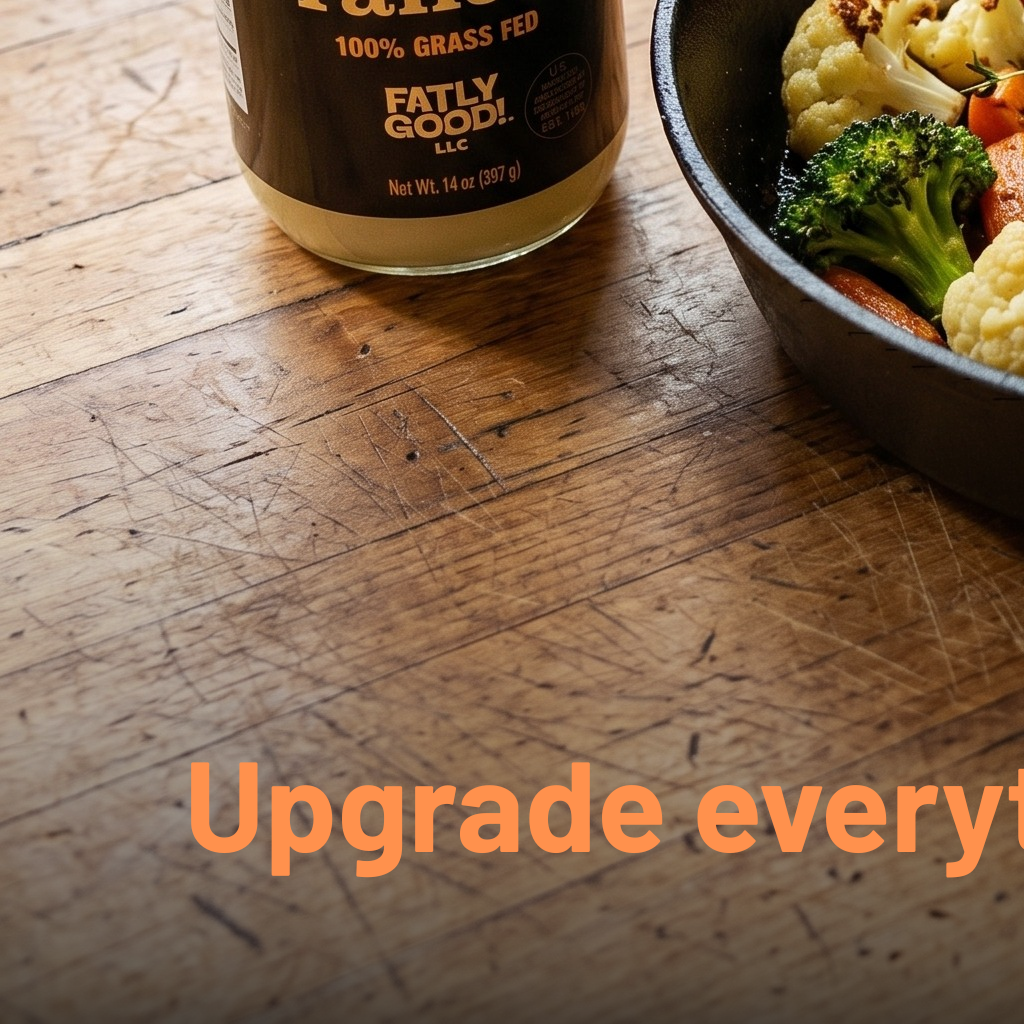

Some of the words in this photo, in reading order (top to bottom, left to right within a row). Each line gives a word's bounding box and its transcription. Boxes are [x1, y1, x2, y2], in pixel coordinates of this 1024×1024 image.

[335, 35, 405, 59] 100%
[413, 24, 494, 58] GRASS
[500, 10, 539, 41] FED
[384, 73, 498, 114] FATLY
[435, 138, 469, 155] LLC
[388, 179, 413, 196] Net
[415, 178, 440, 196] Wt.
[442, 175, 458, 193] 14
[461, 176, 475, 190] oz
[479, 165, 505, 190] (397
[508, 160, 521, 183] g)
